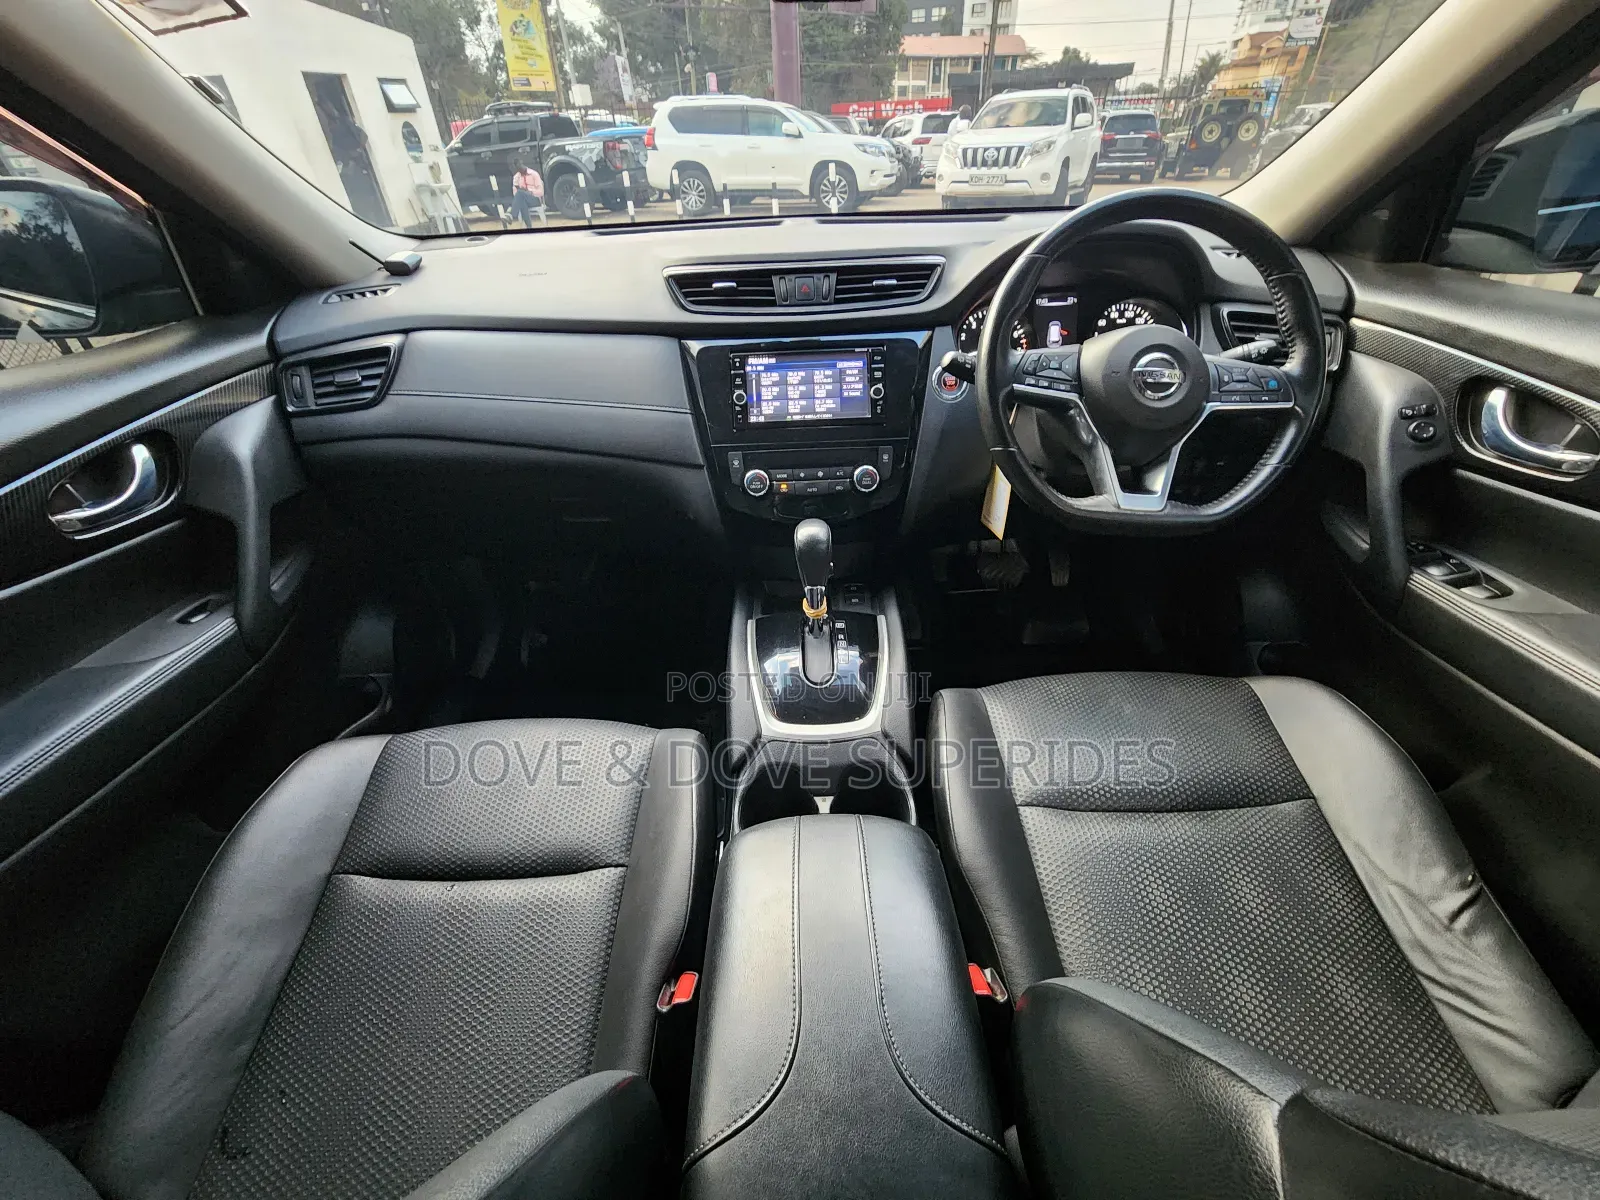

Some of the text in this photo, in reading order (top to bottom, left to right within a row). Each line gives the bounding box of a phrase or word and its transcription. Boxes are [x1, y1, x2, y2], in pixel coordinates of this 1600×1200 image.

[849, 101, 923, 118] Car Wash
[970, 175, 1004, 184] KDH 277A
[1138, 370, 1180, 380] NISSAN
